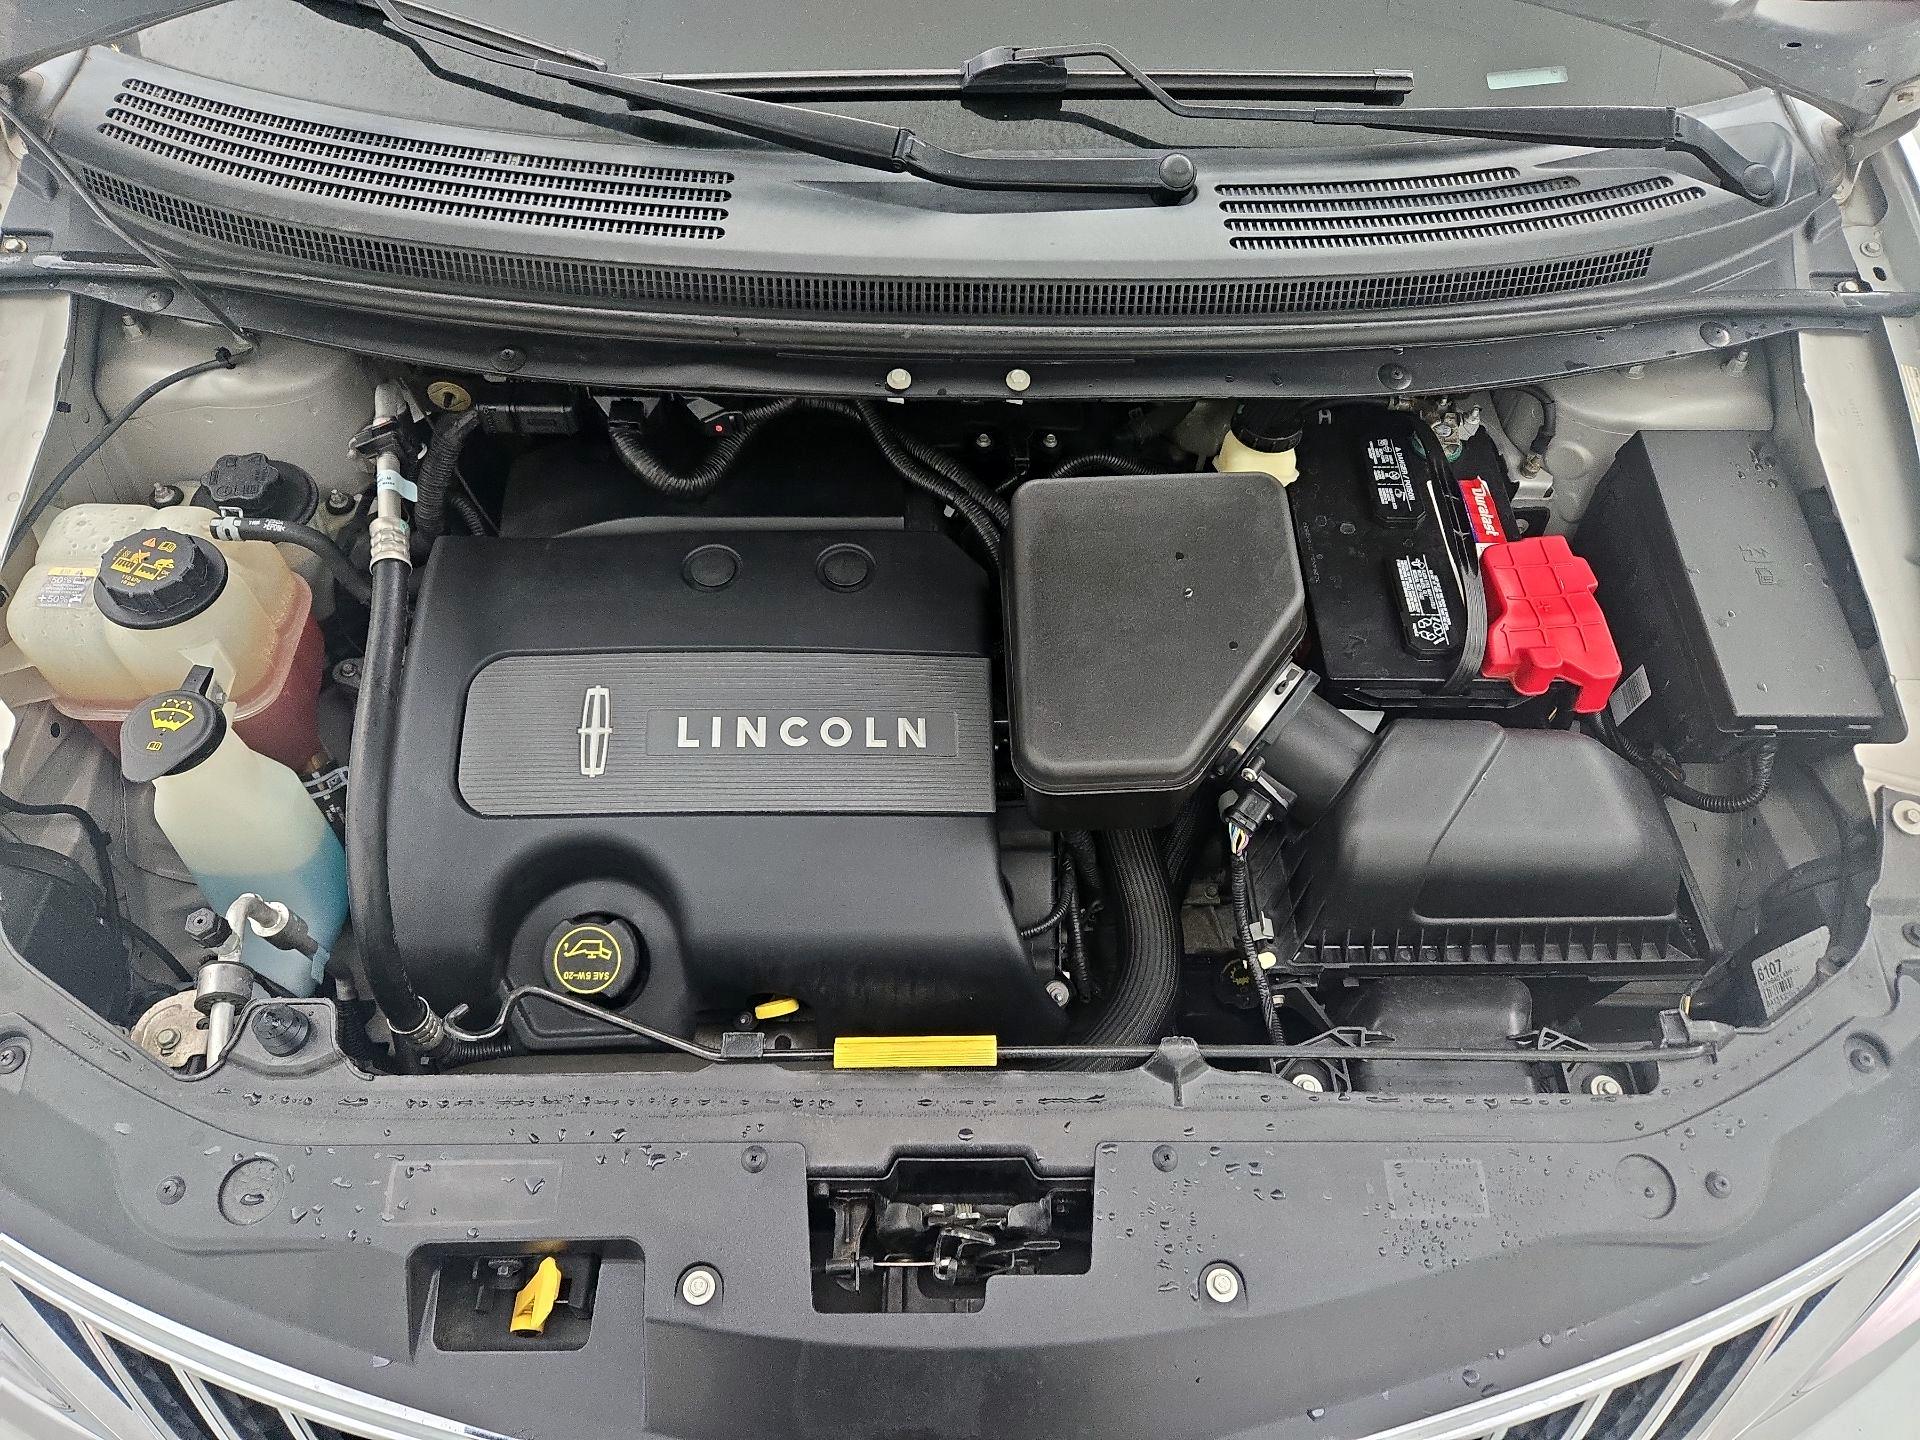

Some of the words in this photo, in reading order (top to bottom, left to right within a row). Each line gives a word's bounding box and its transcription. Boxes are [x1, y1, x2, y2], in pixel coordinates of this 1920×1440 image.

[1396, 452, 1408, 475] DANGER
[1404, 479, 1416, 501] POISON
[1471, 486, 1499, 537] Duralast
[50, 576, 72, 584] 50%
[677, 716, 927, 748] LINCOLN
[563, 971, 592, 981] 5W-20
[593, 971, 610, 981] SAE
[1757, 958, 1781, 981] 6107
